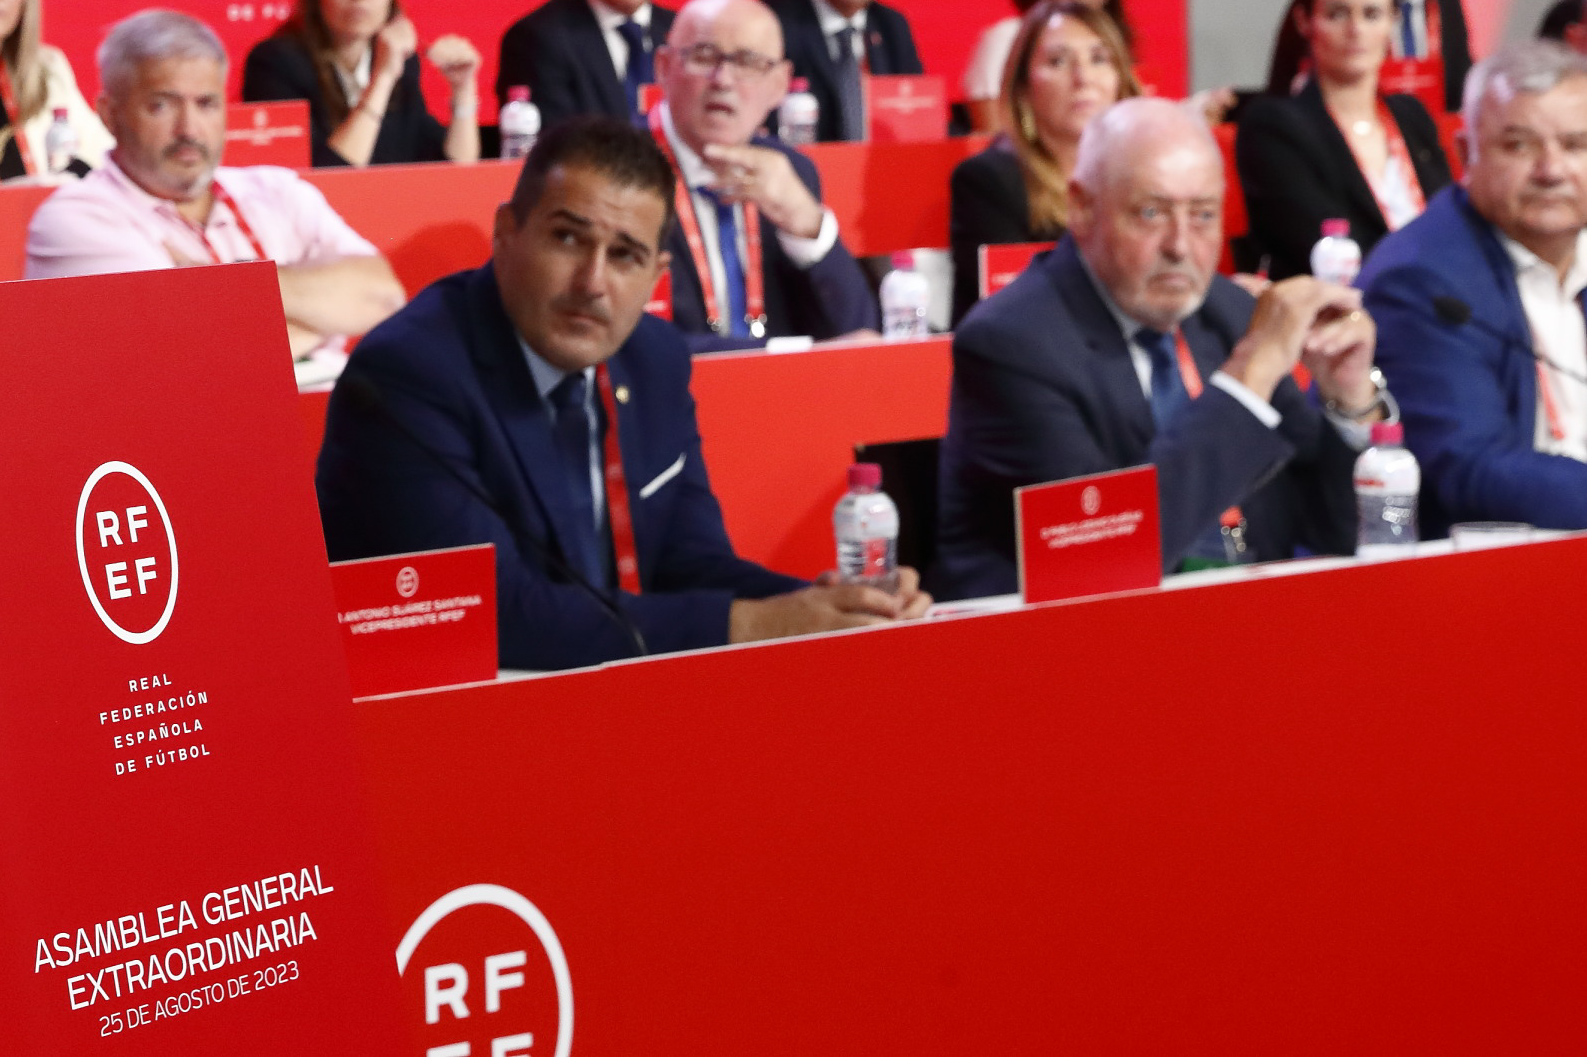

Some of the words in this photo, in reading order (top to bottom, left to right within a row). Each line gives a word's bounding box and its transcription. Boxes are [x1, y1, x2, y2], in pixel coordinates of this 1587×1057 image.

[128, 673, 172, 693] REAL
[99, 690, 208, 726] FEDERACIÓN
[113, 719, 203, 749] ESPAÑOLA
[115, 759, 137, 776] DE
[145, 743, 211, 769] FÚTBOL
[34, 900, 199, 974] ASAMBLEA
[201, 864, 335, 925] GENERAL
[67, 911, 318, 1011] EXTRAORDINARIA
[99, 1011, 124, 1038] 25
[126, 1003, 152, 1029] DE
[154, 985, 225, 1021] AGOSTO
[227, 974, 251, 999] DE
[253, 960, 300, 991] 2023
